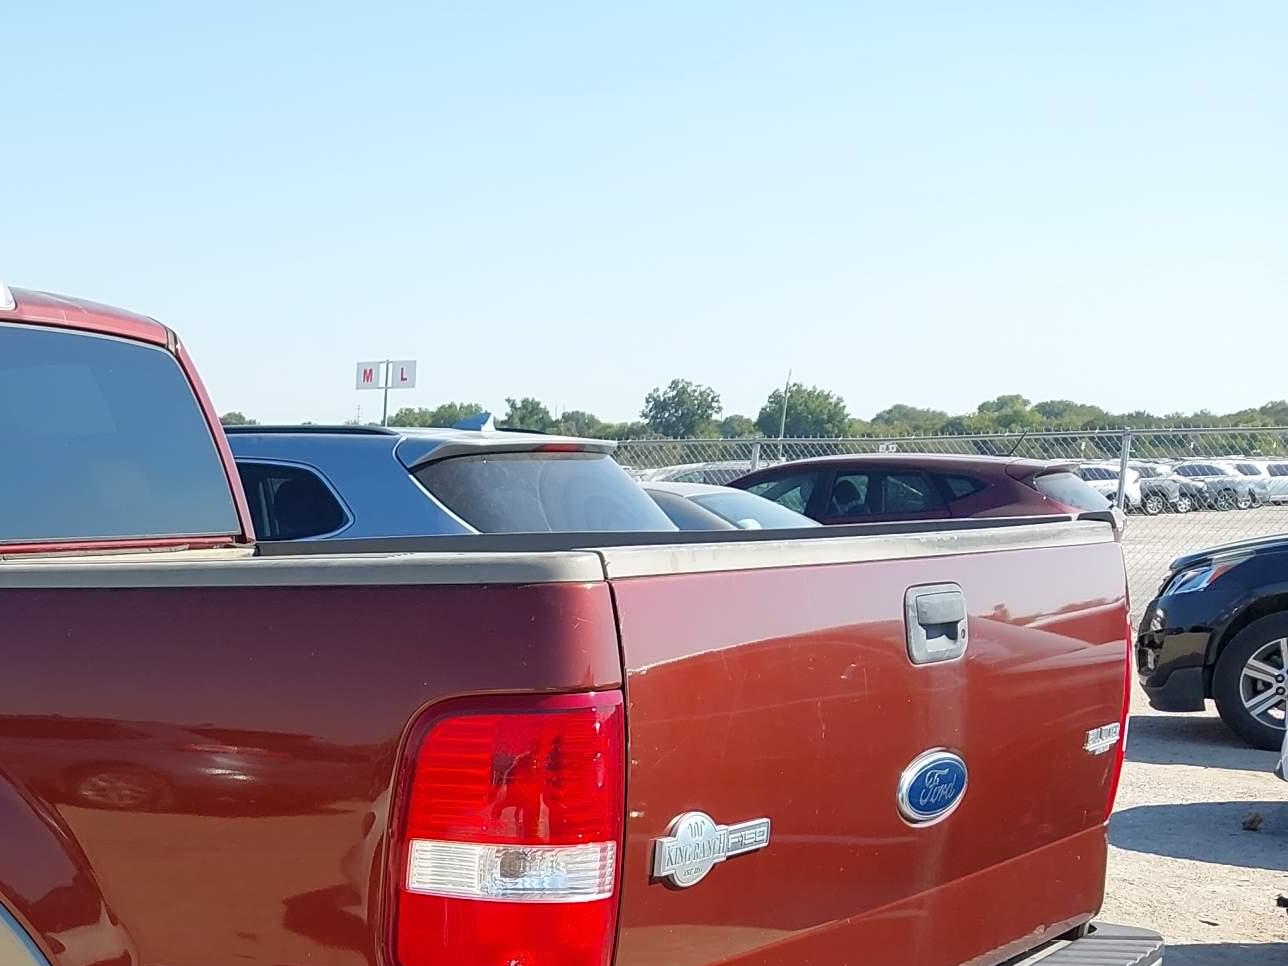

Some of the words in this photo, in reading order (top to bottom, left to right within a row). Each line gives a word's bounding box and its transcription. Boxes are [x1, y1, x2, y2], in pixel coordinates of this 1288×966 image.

[362, 368, 372, 382] M
[400, 367, 407, 381] L
[919, 767, 957, 806] Ford
[665, 841, 691, 869] KING
[691, 830, 727, 863] RANCH
